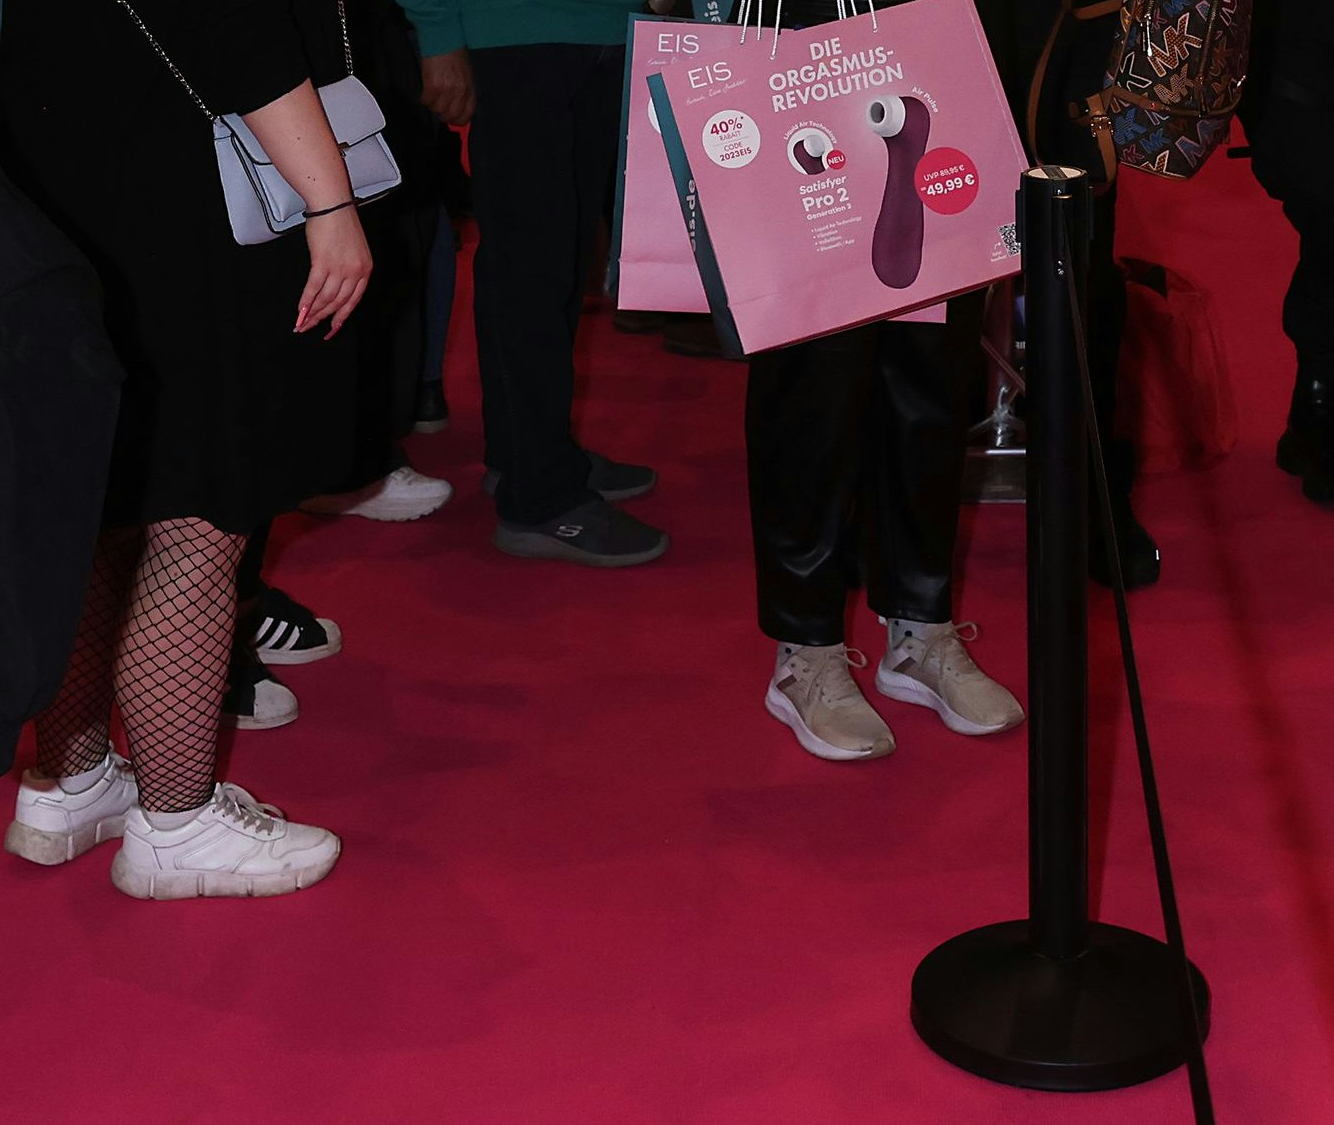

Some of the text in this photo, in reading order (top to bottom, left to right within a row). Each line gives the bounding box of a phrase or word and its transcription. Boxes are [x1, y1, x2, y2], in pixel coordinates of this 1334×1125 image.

[658, 33, 700, 54] EIS
[809, 37, 843, 61] DIE
[1147, 11, 1203, 78] MK
[687, 61, 732, 89] EIS
[769, 45, 894, 92] ORGASMUS-
[771, 62, 904, 113] REVOLUTION
[719, 146, 752, 162] 2023EIS
[724, 141, 743, 152] CODE
[827, 155, 845, 165] NEU
[798, 175, 847, 195] Satisfyer
[923, 171, 939, 181] UVP
[927, 177, 963, 196] 49,99
[964, 173, 975, 186] €
[802, 187, 849, 212] Pro 2
[806, 205, 846, 221] Generation
